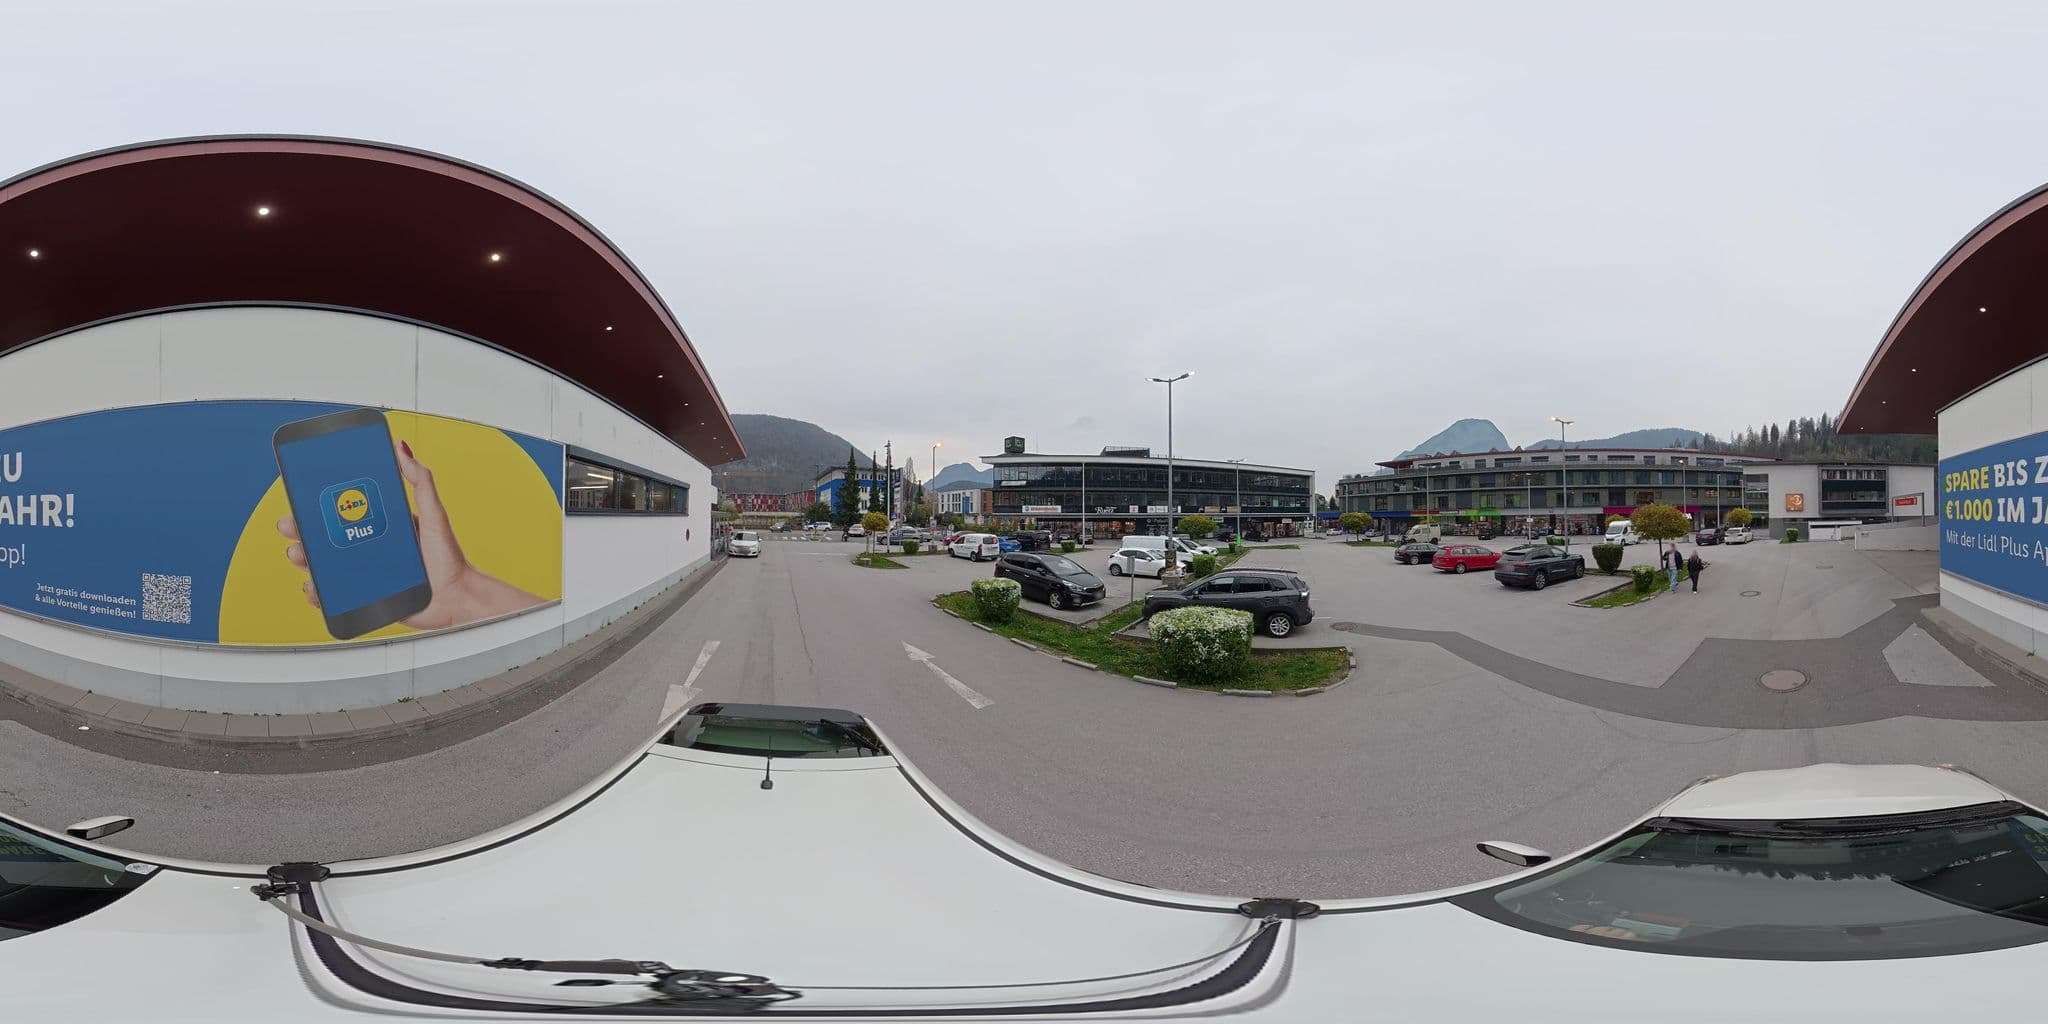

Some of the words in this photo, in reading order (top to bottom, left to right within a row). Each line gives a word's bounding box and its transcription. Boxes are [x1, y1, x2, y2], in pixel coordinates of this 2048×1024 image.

[0, 452, 23, 483] U
[1945, 466, 1989, 493] SPARE
[1994, 459, 2028, 488] BIS
[0, 494, 75, 528] AHR!
[1946, 498, 1993, 522] €1.000
[1997, 497, 2025, 523] IM
[2032, 496, 2048, 525] J
[345, 526, 374, 541] Plus
[1945, 529, 1959, 545] Mit
[1961, 532, 1975, 548] der
[1978, 534, 1998, 553] Lidl
[2000, 536, 2029, 558] Plus
[2033, 540, 2048, 567] A
[34, 593, 41, 602] &
[42, 596, 57, 605] alle
[57, 598, 88, 612] Vorteile
[89, 605, 136, 619] genießen!
[36, 582, 54, 594] Jetzt
[55, 586, 78, 598] gratis
[80, 590, 136, 606] downloaden
